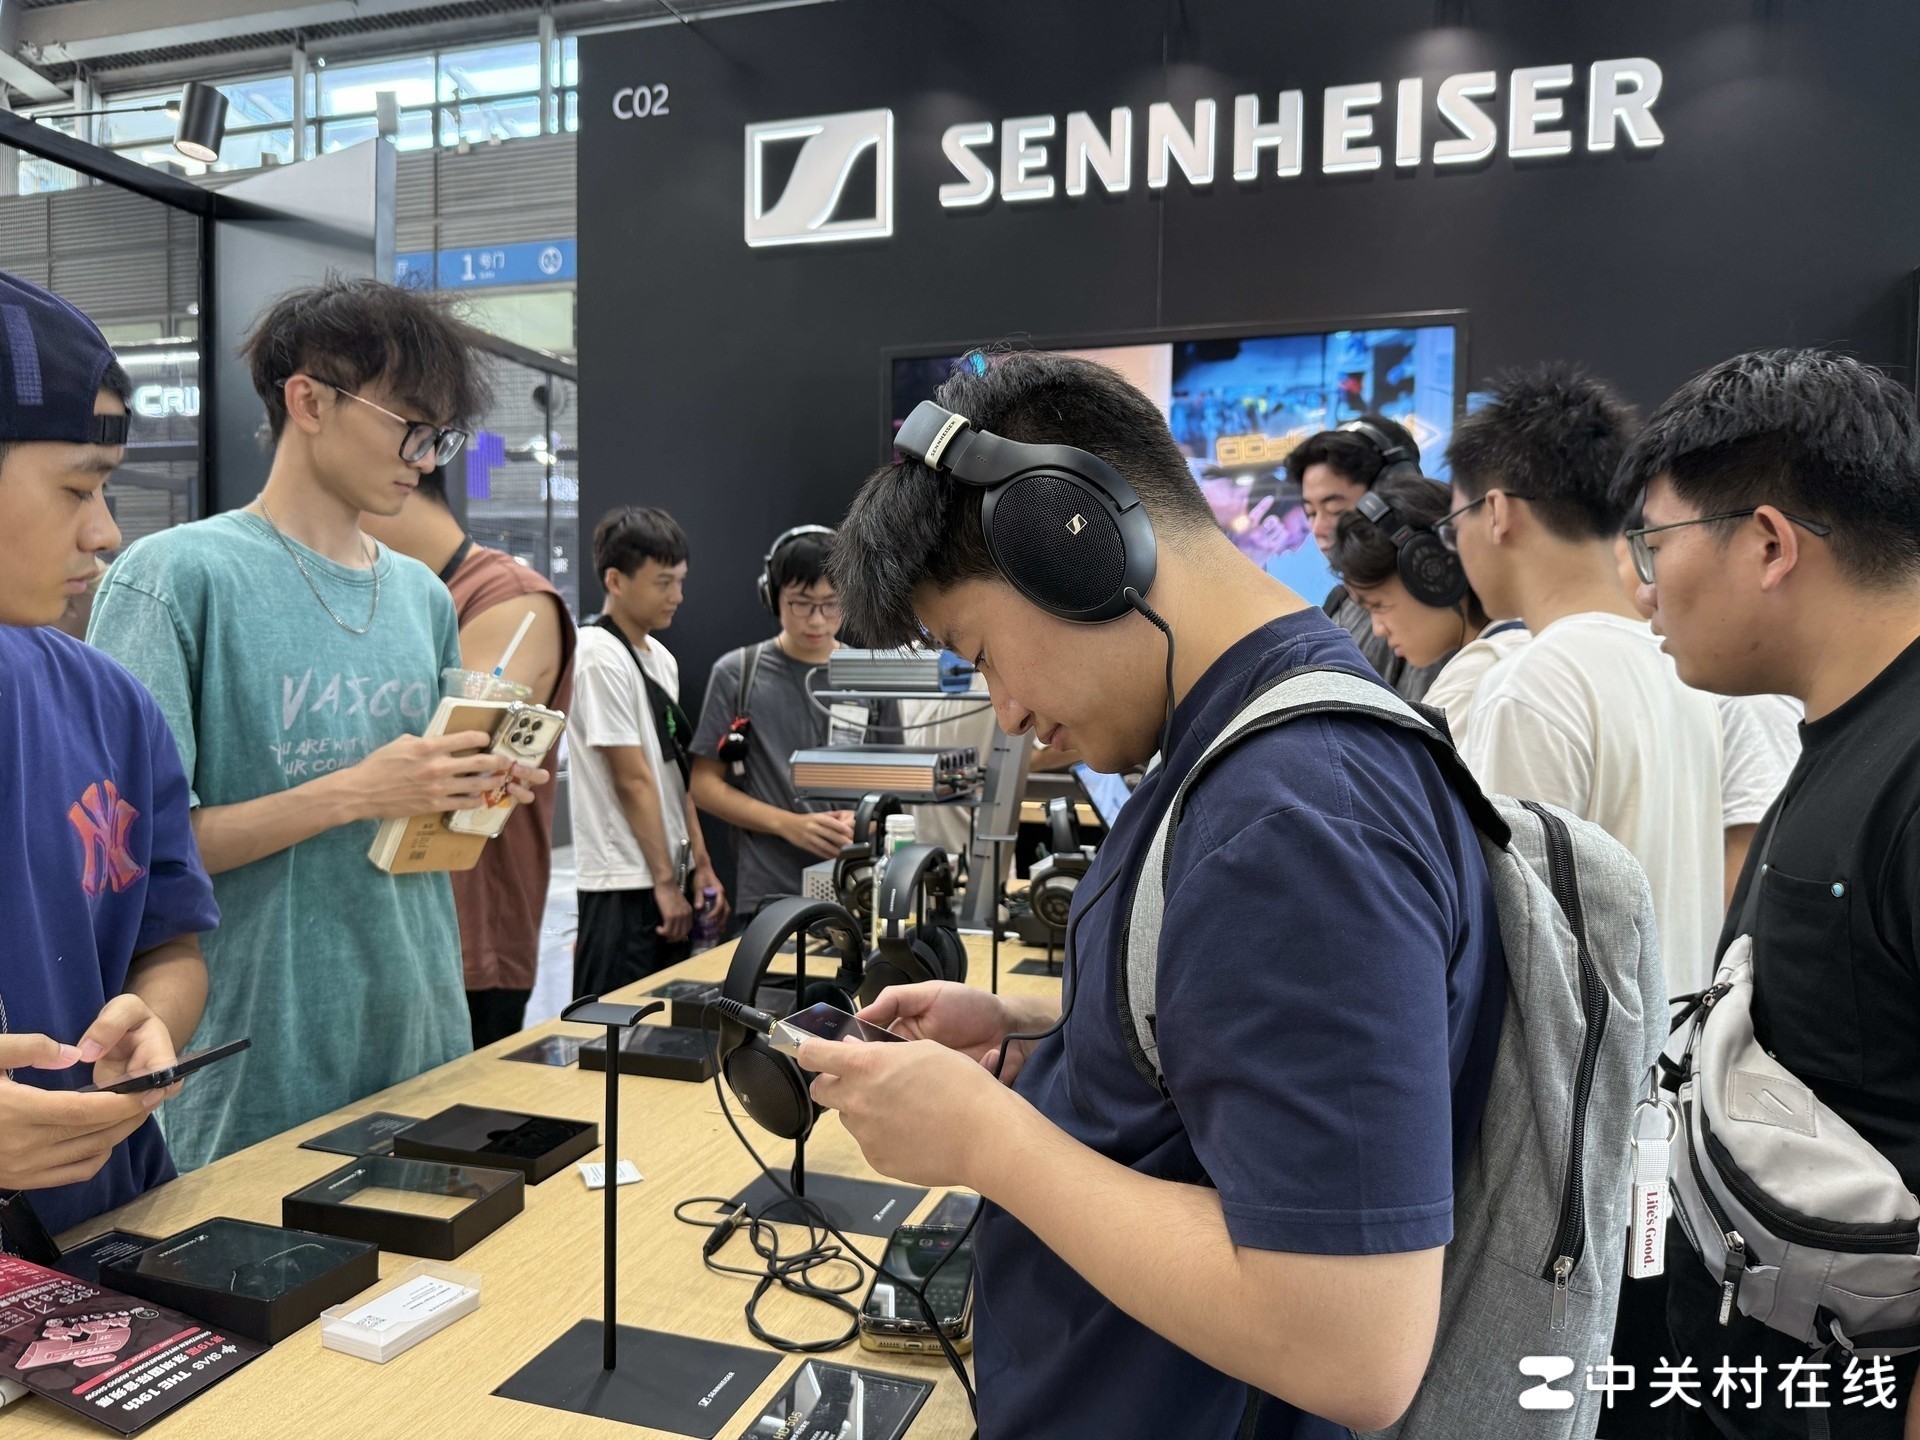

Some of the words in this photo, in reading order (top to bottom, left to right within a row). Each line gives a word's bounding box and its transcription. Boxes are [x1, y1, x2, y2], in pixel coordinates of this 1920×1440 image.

[612, 83, 670, 121] C02
[938, 57, 1664, 207] SENNHEISER
[930, 421, 956, 457] SENNHEISER
[283, 667, 430, 731] VASCO
[295, 736, 331, 757] ARE
[1645, 1191, 1659, 1226] Life's
[1643, 1228, 1657, 1269] Good.
[59, 1288, 100, 1305] 2025
[84, 1384, 107, 1402] SHOW
[95, 1354, 190, 1409] 深圳国际音频展
[162, 1370, 192, 1391] THE
[122, 1388, 161, 1411] 19th
[773, 1427, 791, 1440] HD
[785, 1411, 803, 1427] 505
